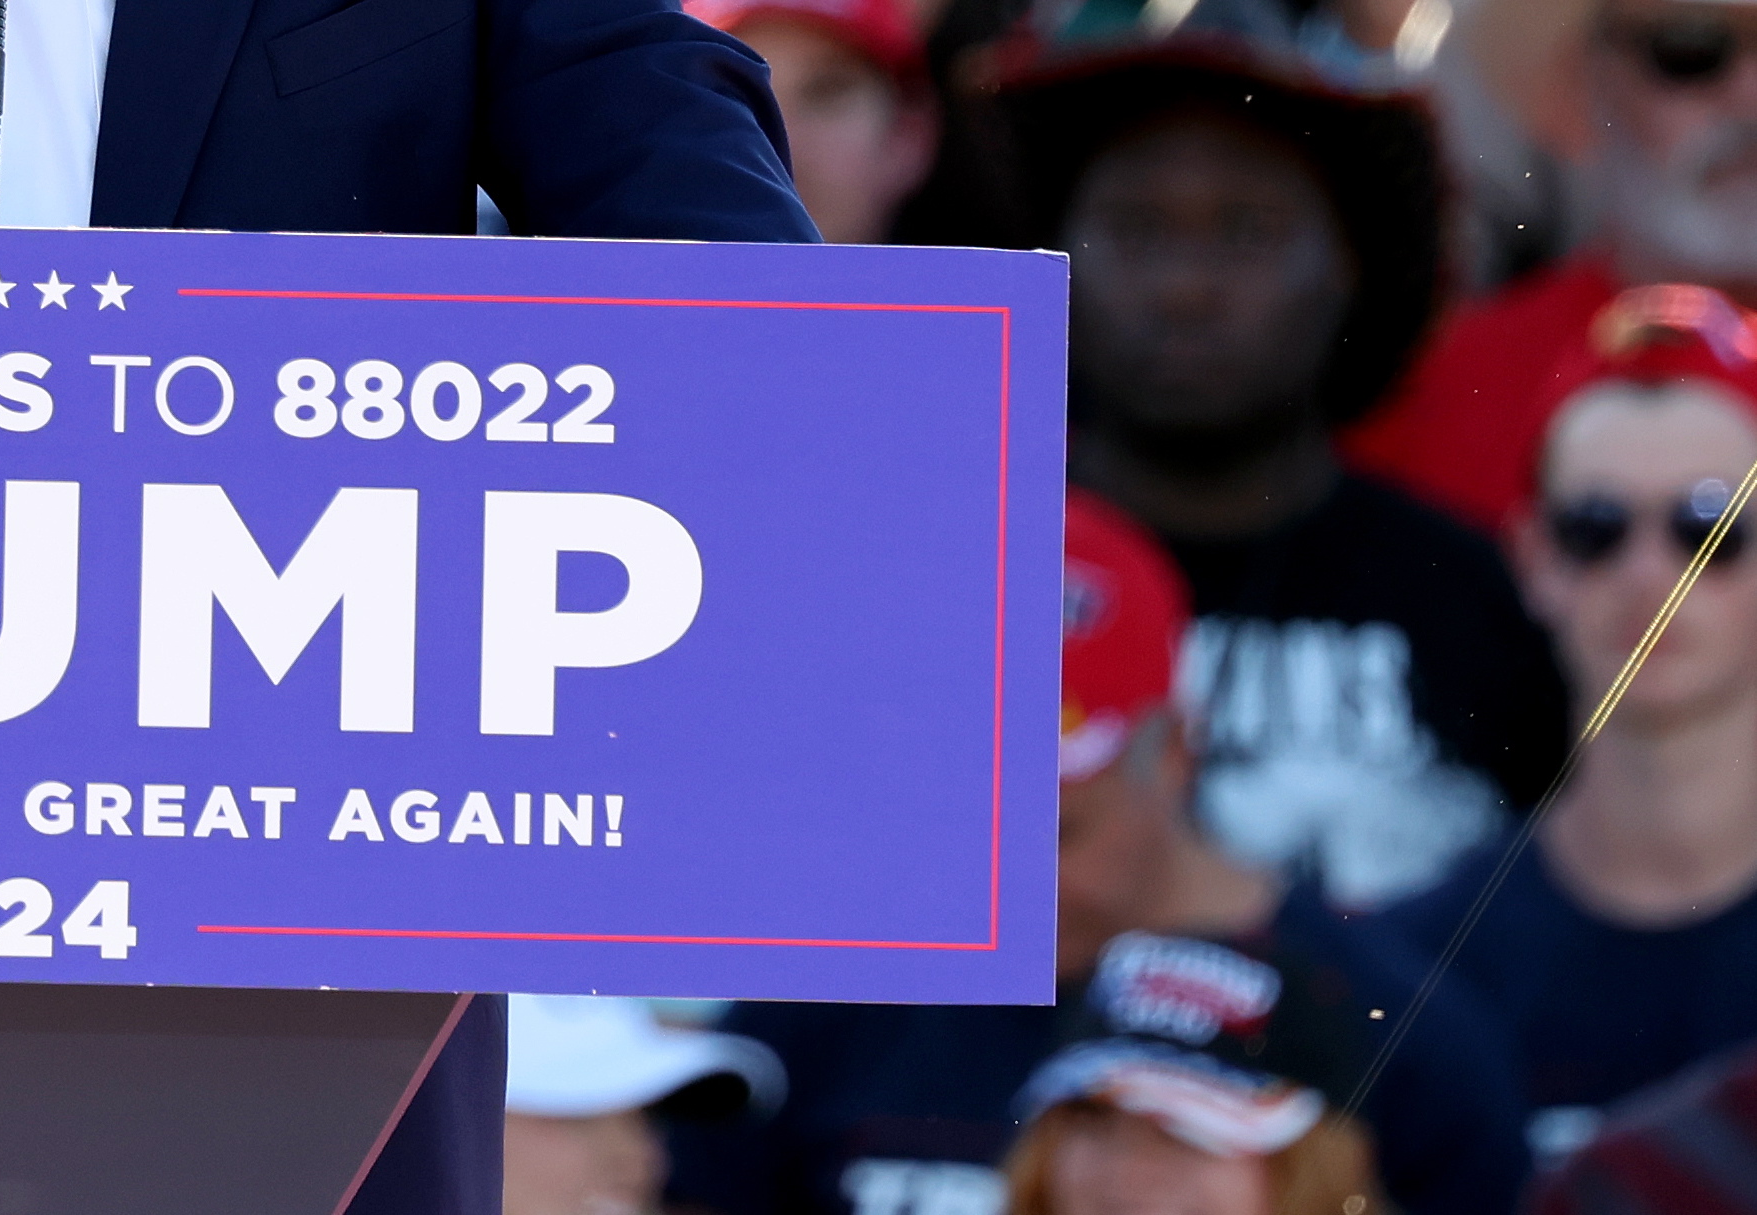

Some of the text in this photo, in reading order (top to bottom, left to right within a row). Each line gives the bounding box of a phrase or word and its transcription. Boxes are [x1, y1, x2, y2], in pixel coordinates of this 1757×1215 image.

[89, 354, 235, 436] TO
[273, 358, 615, 444] 88022
[23, 781, 297, 839] GREAT
[328, 788, 625, 847] AGAIN!
